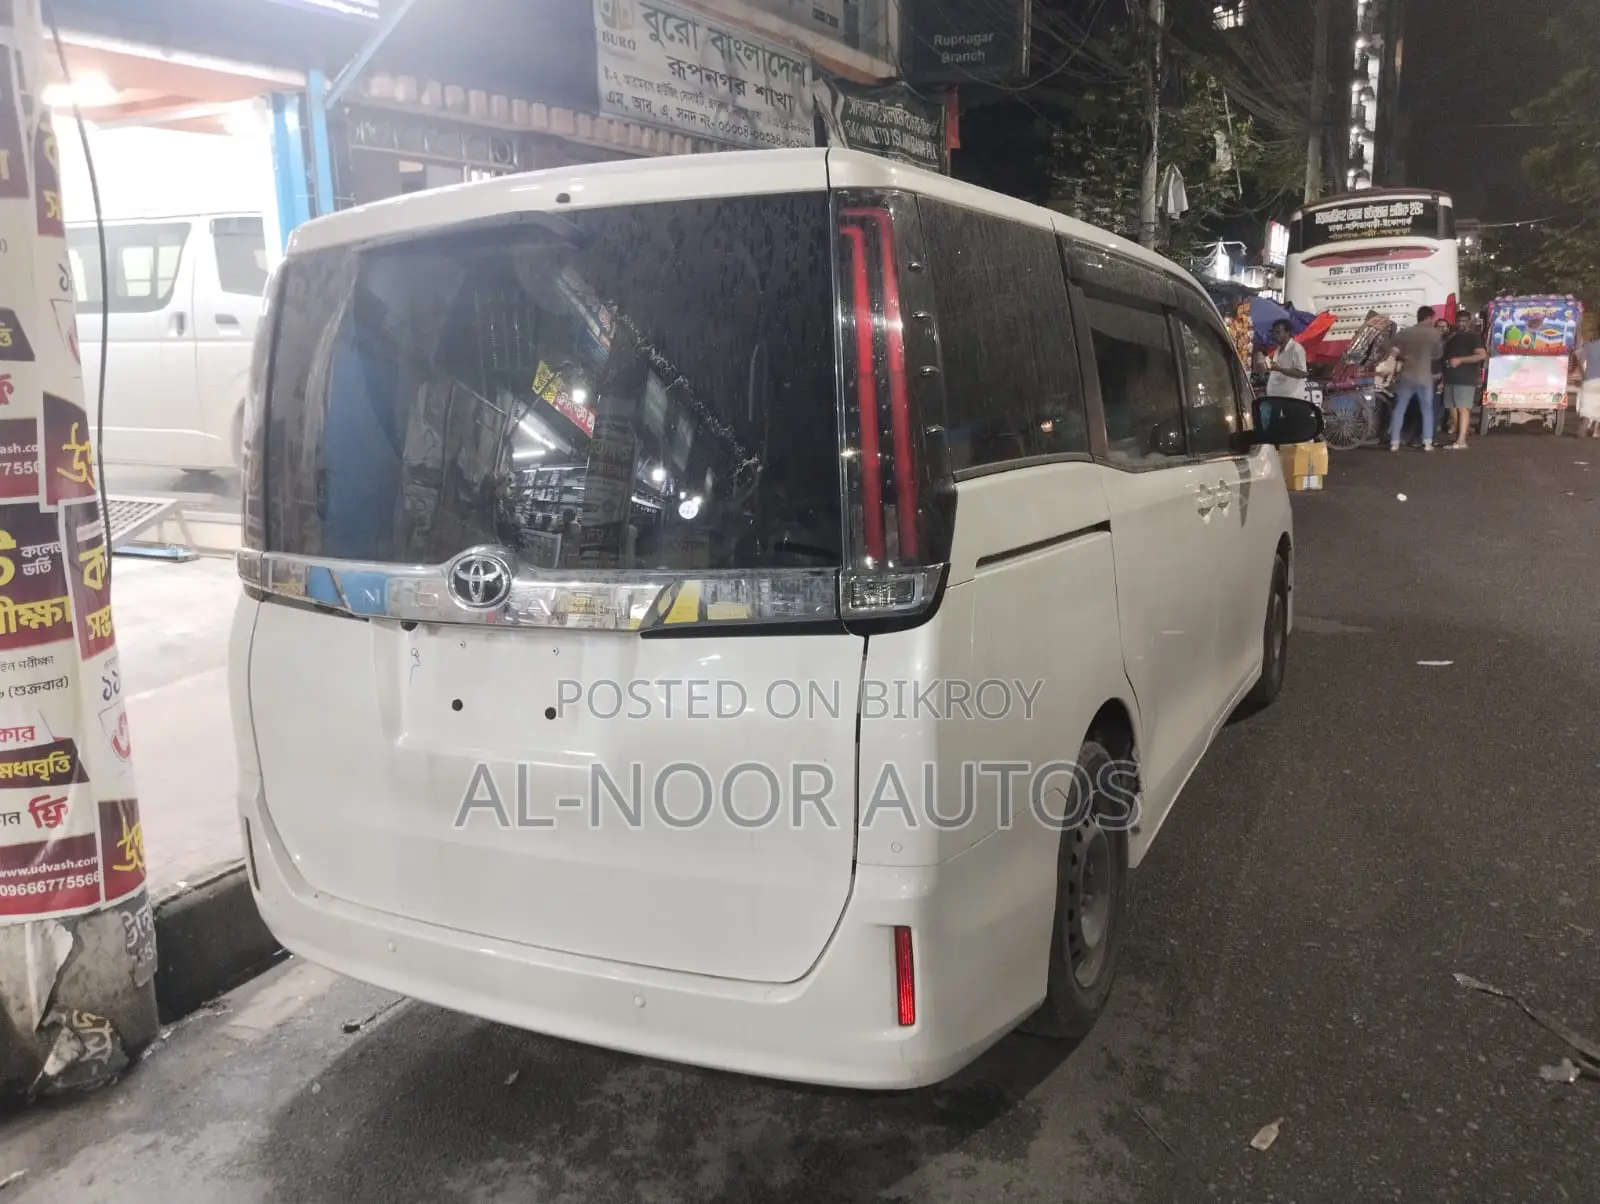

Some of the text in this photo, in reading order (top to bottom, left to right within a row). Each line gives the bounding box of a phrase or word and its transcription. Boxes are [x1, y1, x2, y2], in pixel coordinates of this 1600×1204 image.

[641, 4, 807, 88] বুরো বাংলাদেশ
[934, 32, 994, 47] Rupnagar
[941, 50, 985, 63] Branch
[664, 55, 794, 113] রূপনগর শাখা
[22, 556, 52, 576] ভর্তি
